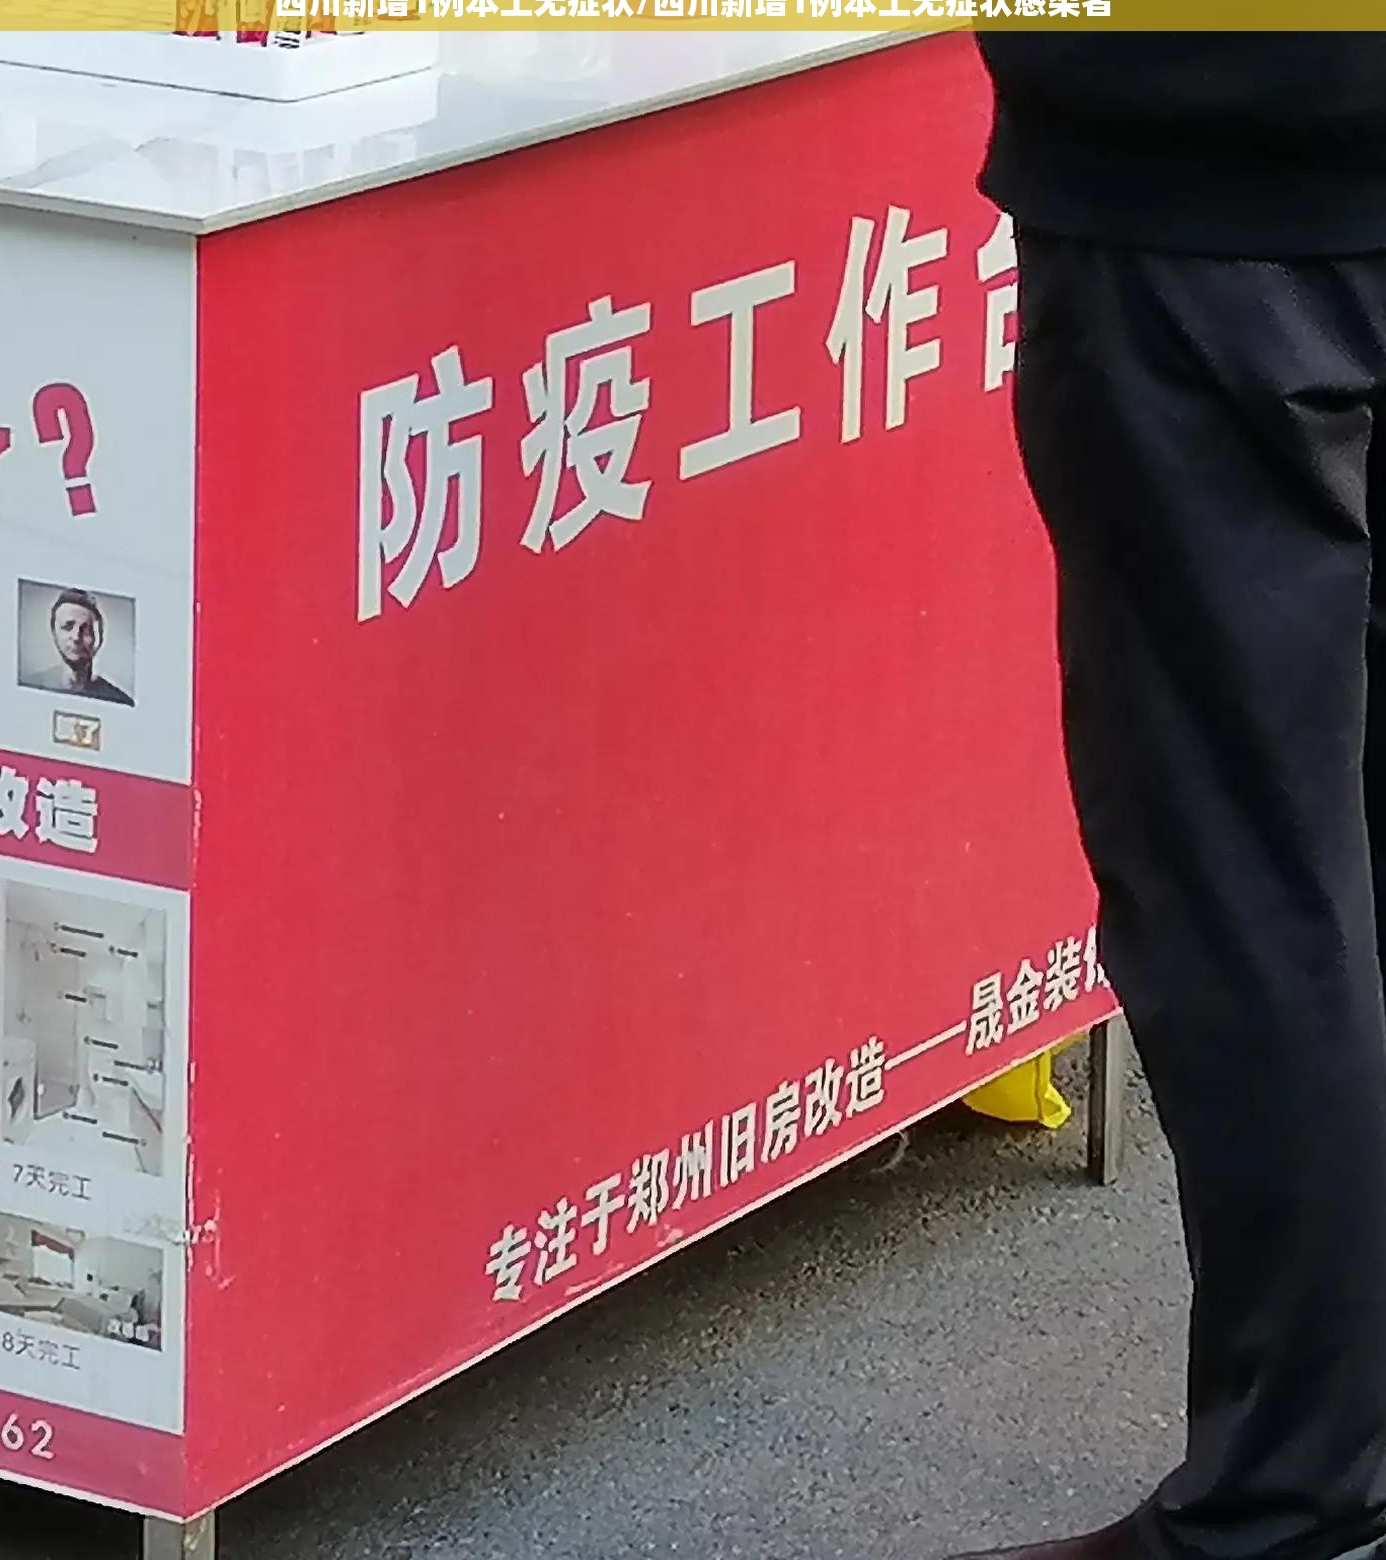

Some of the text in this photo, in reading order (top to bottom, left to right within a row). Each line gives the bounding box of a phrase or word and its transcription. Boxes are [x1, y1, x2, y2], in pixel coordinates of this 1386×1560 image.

[12, 1163, 93, 1201] 7天完工
[1, 1330, 82, 1370] 8天完工
